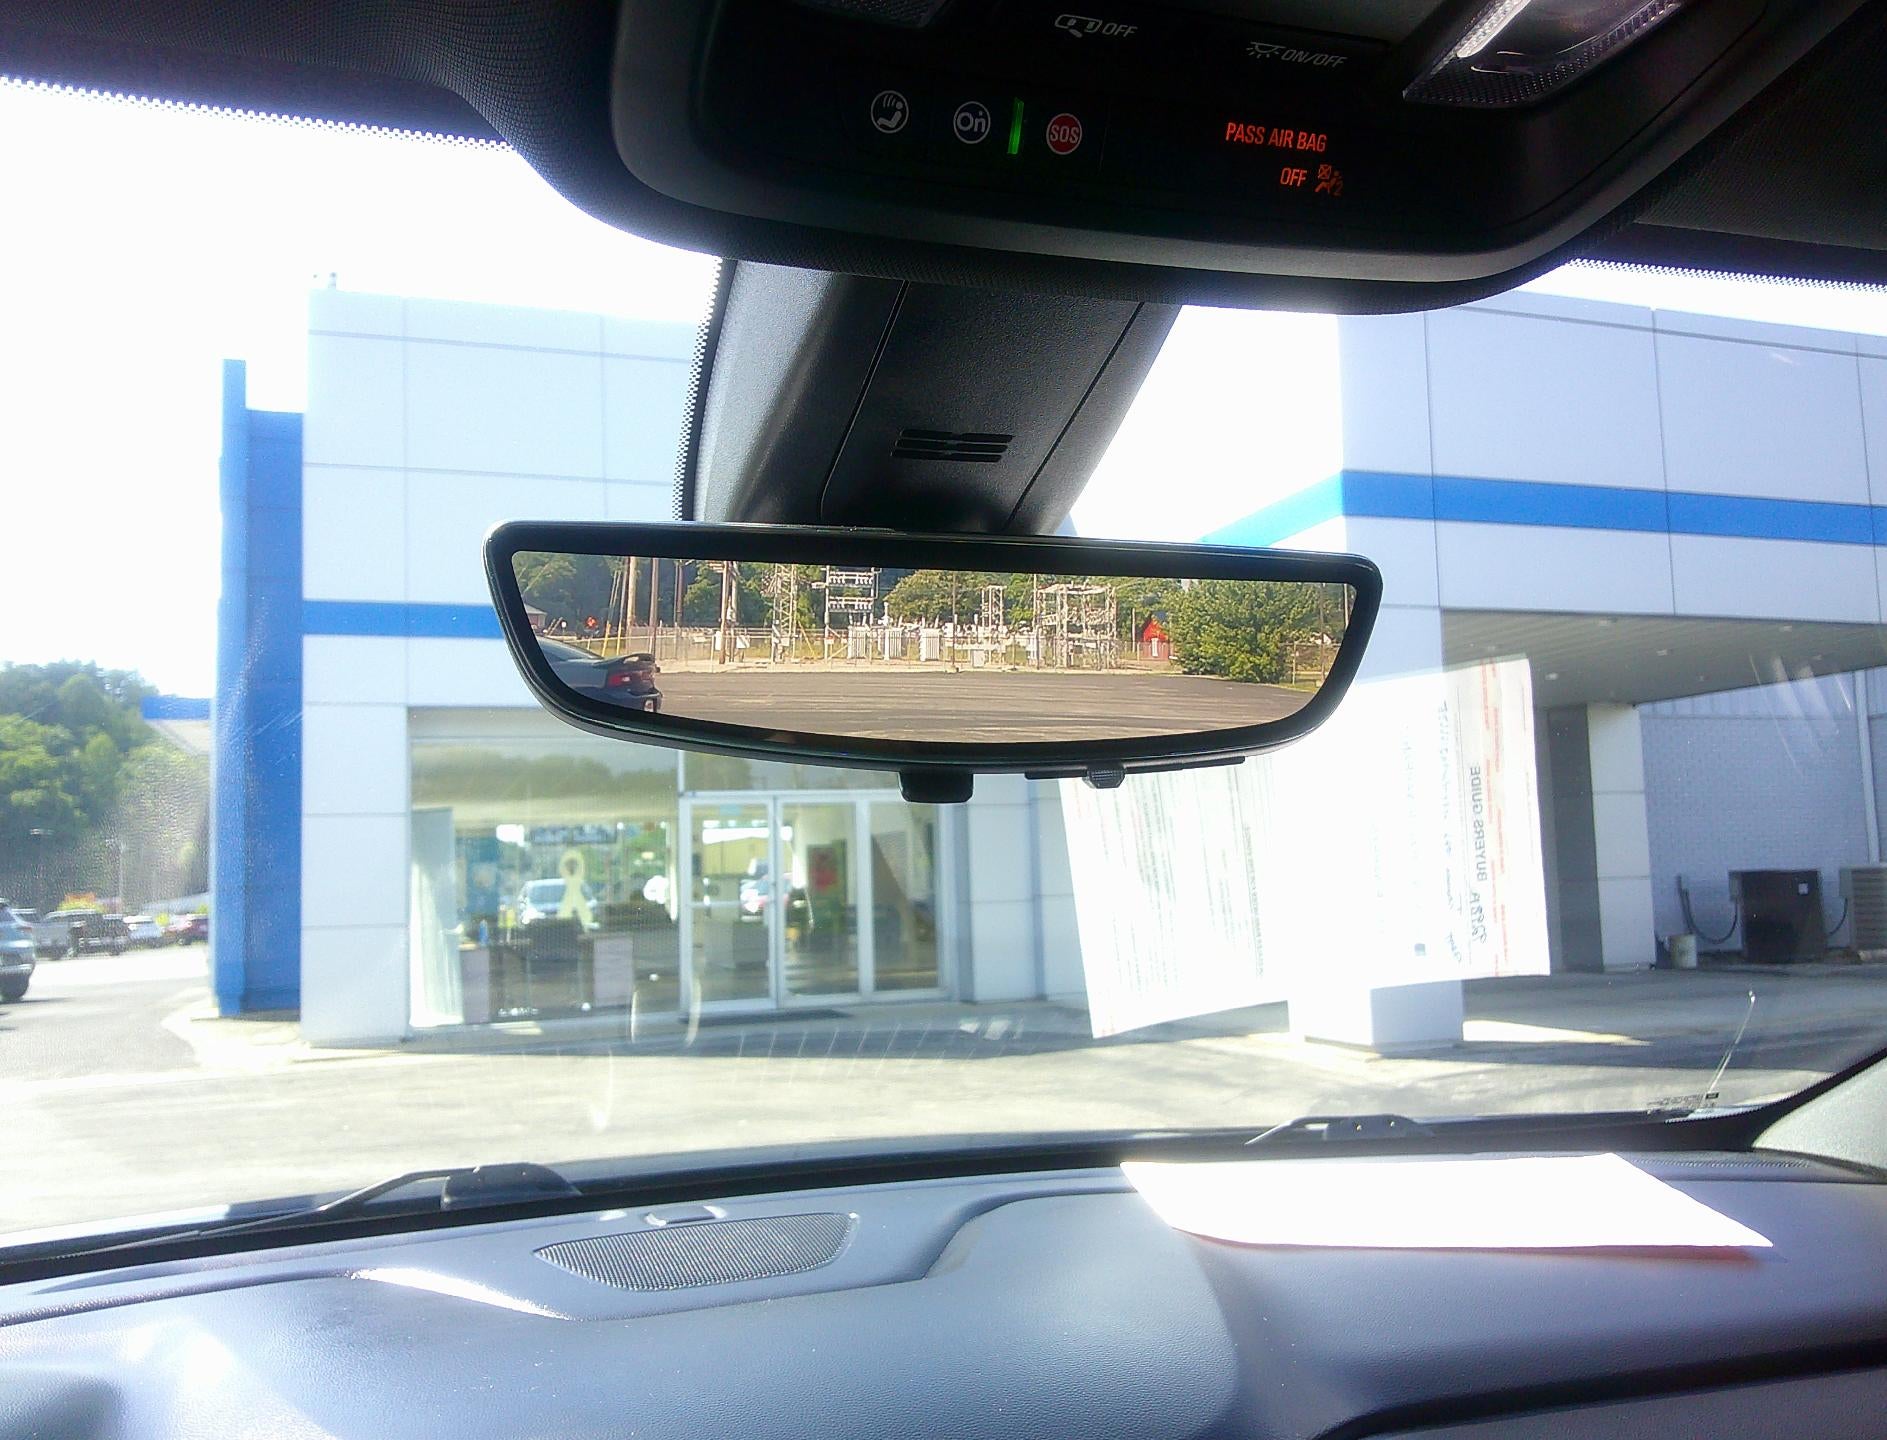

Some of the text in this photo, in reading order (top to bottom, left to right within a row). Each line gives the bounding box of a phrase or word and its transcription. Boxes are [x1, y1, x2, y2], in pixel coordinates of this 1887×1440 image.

[1102, 22, 1138, 37] OFF
[1281, 49, 1348, 68] ON/OFF
[1050, 124, 1080, 144] SOS
[1225, 121, 1327, 152] PASS AIR BAG
[1280, 167, 1308, 187] OFF
